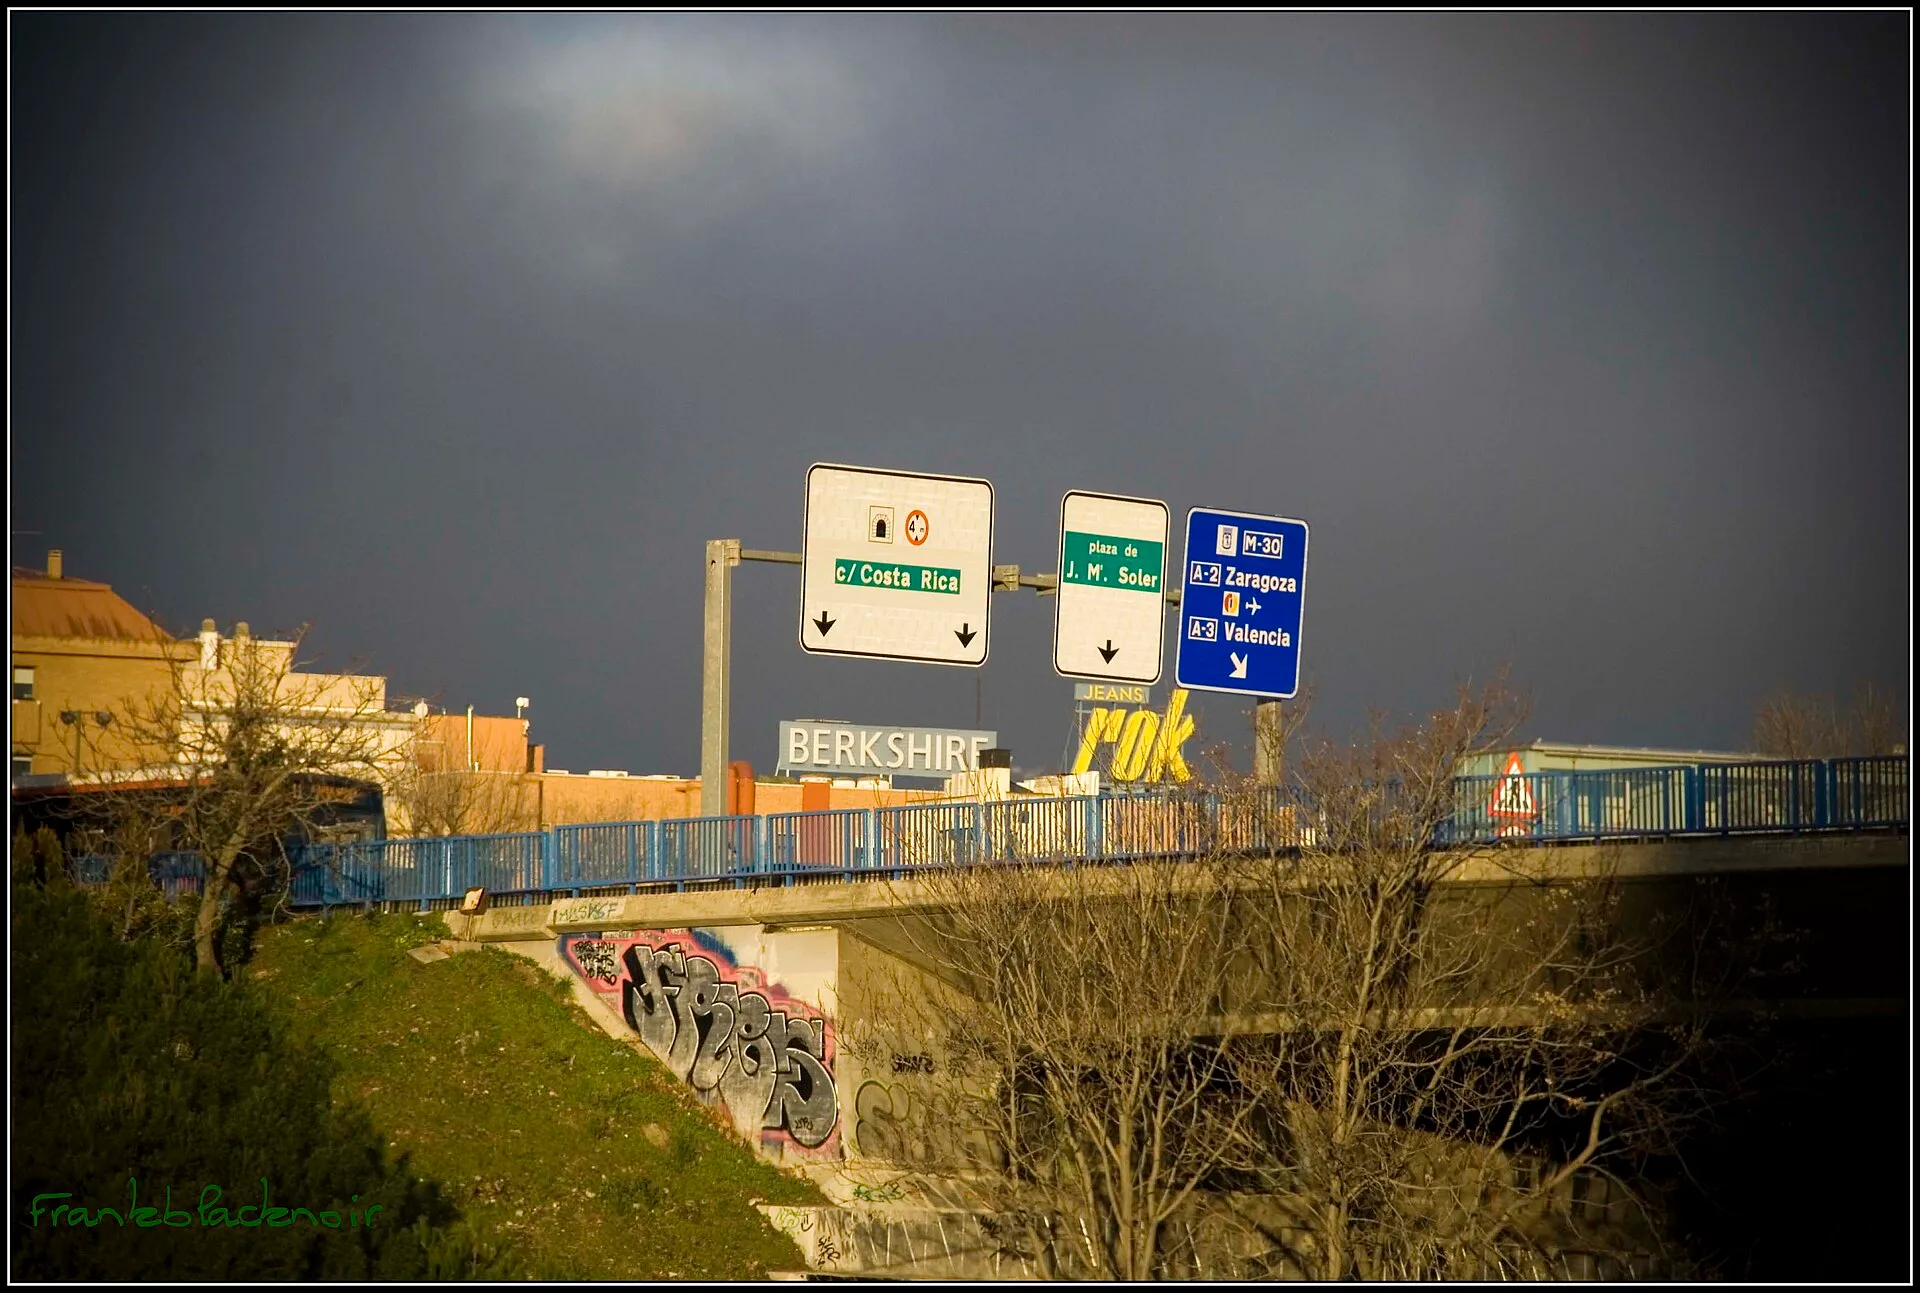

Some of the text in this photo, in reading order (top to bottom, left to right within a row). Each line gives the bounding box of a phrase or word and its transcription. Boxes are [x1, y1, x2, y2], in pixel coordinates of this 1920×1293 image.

[908, 520, 915, 533] 4
[1088, 540, 1138, 557] plaza de
[1245, 536, 1281, 555] M-30
[921, 570, 958, 592] Rica
[1066, 560, 1079, 579] J.
[1118, 566, 1158, 588] Soler
[1193, 565, 1297, 593] A-2 Zaragoza
[1191, 620, 1291, 647] A-3 Valencia
[1083, 684, 1144, 702] JEANS
[1072, 689, 1195, 783] rok
[789, 727, 989, 772] BERKSHIRE
